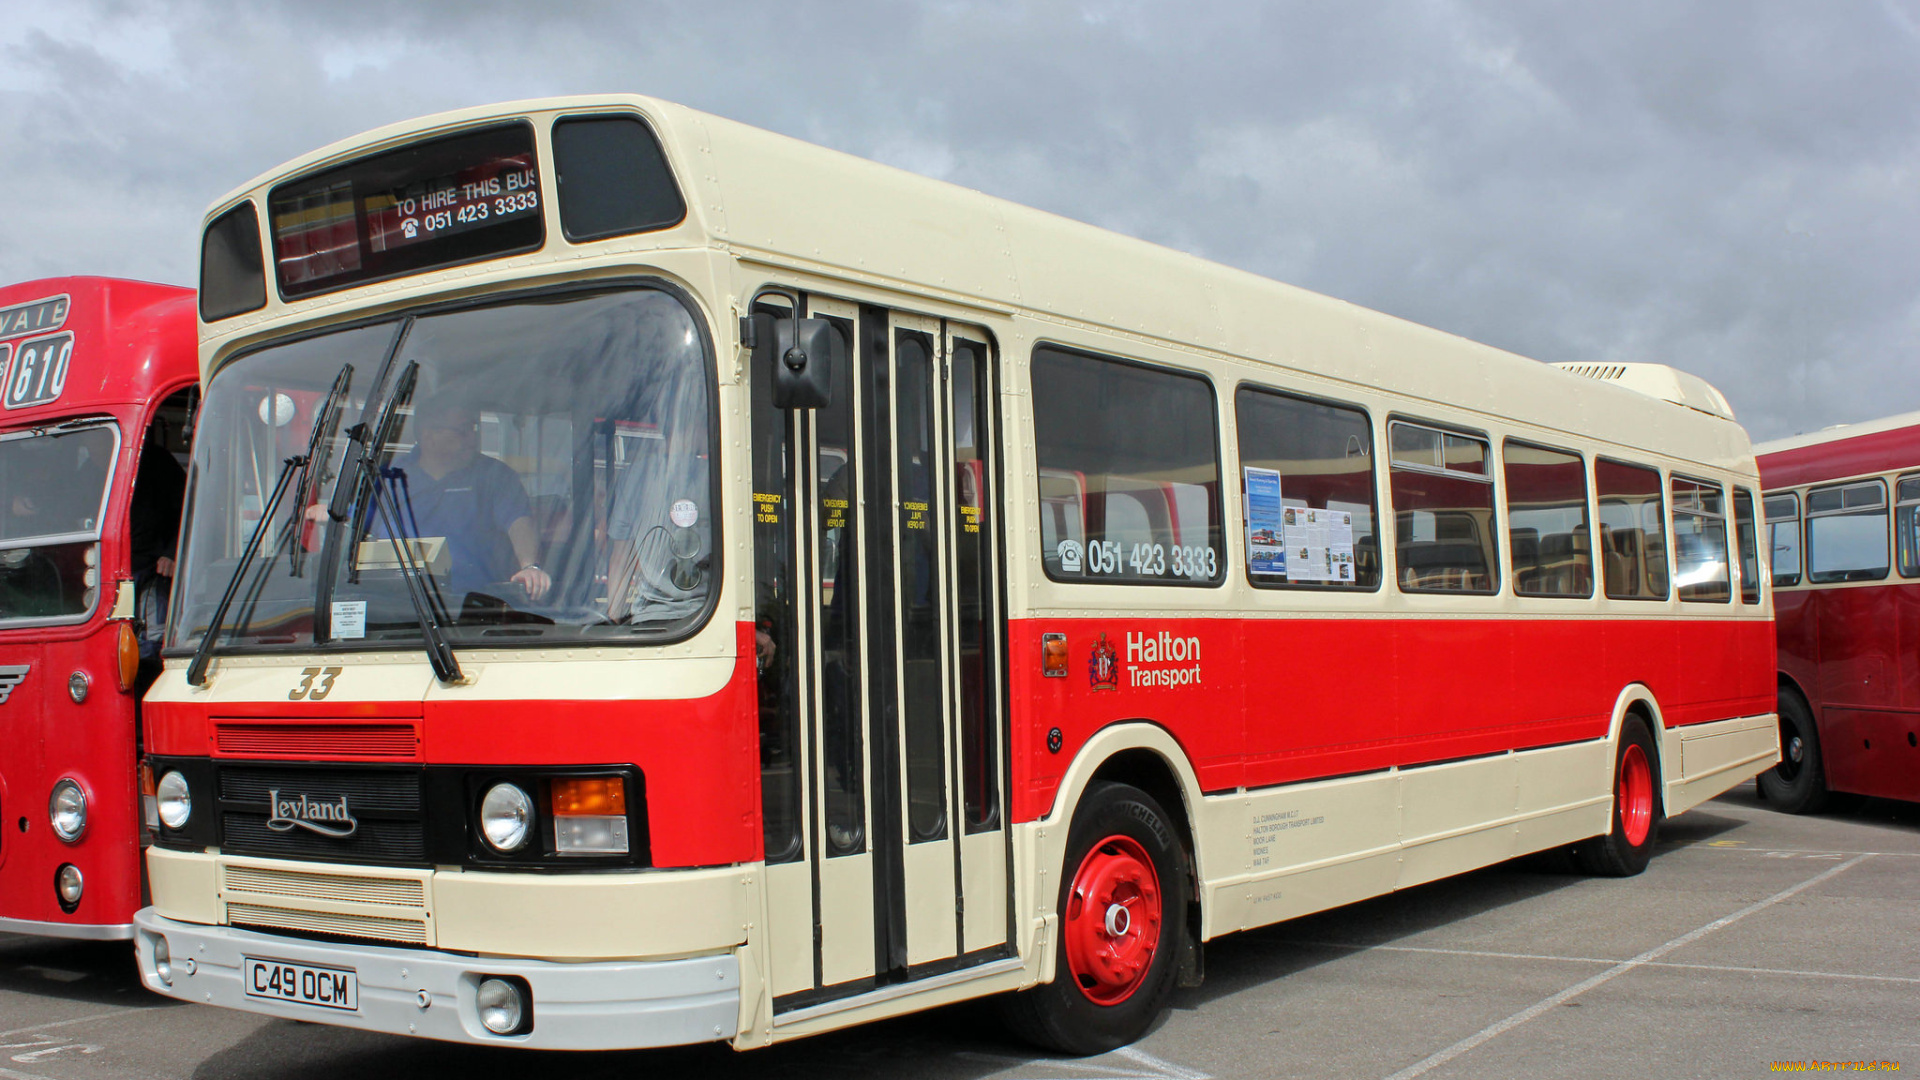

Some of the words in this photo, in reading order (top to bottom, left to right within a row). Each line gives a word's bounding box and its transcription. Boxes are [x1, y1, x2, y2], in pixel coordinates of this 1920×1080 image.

[395, 198, 415, 217] TO
[422, 188, 457, 211] HIRE
[462, 177, 500, 200] THIS
[424, 210, 452, 231] 051
[457, 202, 489, 223] 423
[495, 191, 538, 216] 3333
[13, 341, 73, 401] 610
[753, 493, 781, 503] EMERGENCY
[761, 504, 774, 512] PUSH
[757, 514, 764, 522] TO
[765, 514, 777, 523] OPEN
[1088, 539, 1123, 573] 051
[1130, 543, 1165, 575] 423
[1171, 544, 1217, 577] 3333
[1127, 631, 1200, 662] Halton
[288, 667, 343, 700] 33
[1127, 664, 1201, 689] Transport
[267, 787, 355, 835] Leyland
[1113, 801, 1170, 846] MICHELIN
[1253, 825, 1268, 834] HALTON
[1269, 822, 1288, 832] BOROUGH
[1289, 818, 1309, 829] TRANSPORT
[1310, 816, 1324, 825] LIMITED
[254, 963, 296, 997] C49
[302, 970, 347, 1005] OCM
